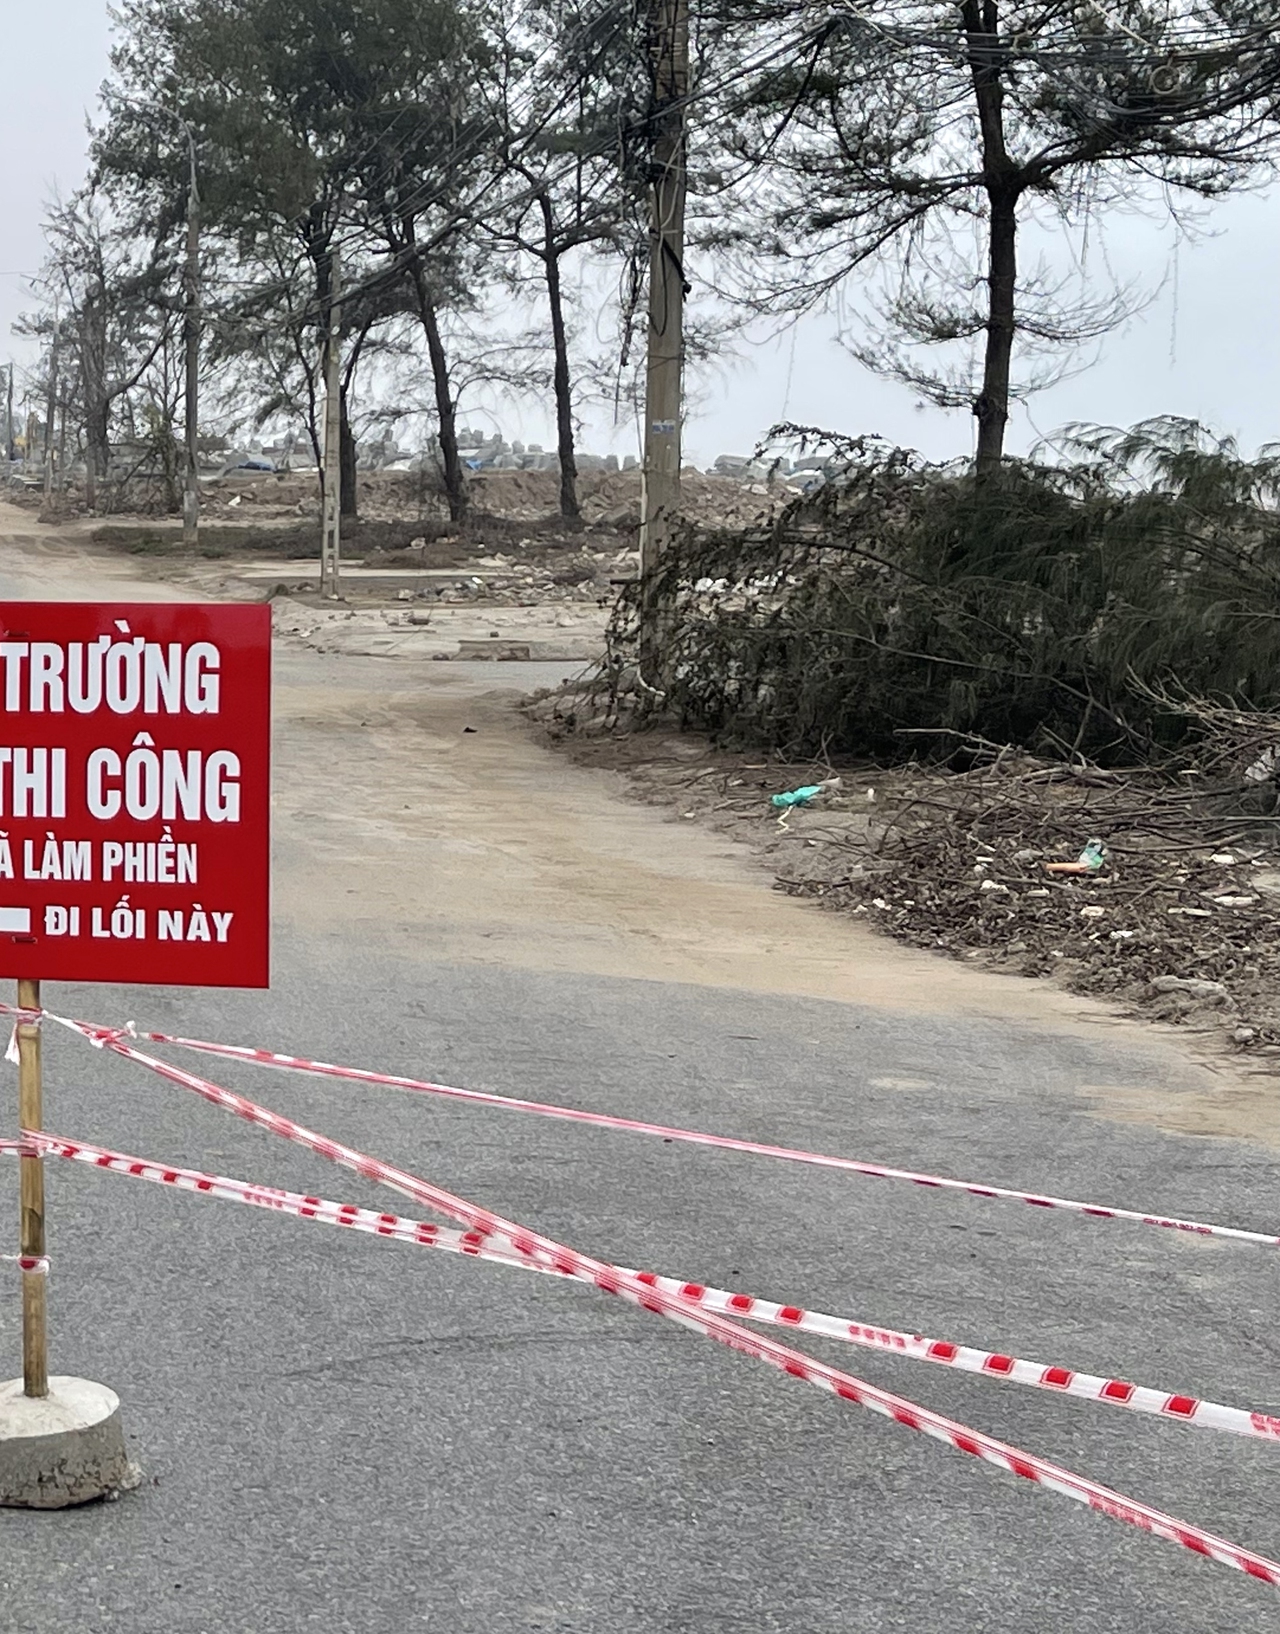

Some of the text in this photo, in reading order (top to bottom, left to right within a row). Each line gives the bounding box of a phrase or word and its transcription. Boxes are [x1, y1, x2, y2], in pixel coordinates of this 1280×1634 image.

[87, 731, 241, 823] CÔNG
[24, 832, 92, 881] LÀM
[102, 825, 198, 884] PHIỀN
[43, 896, 234, 943] ĐI LỐI NÀY
